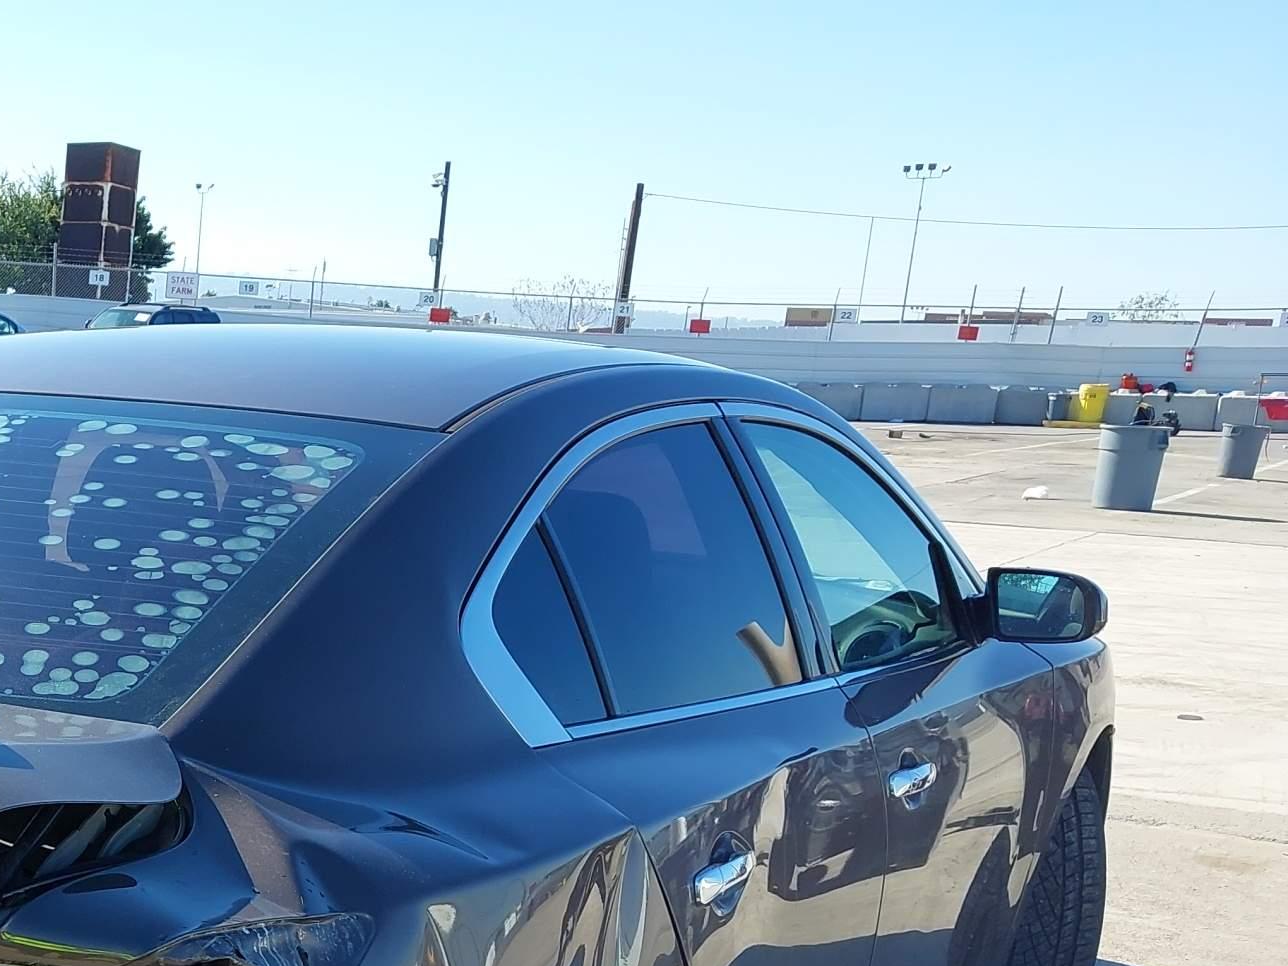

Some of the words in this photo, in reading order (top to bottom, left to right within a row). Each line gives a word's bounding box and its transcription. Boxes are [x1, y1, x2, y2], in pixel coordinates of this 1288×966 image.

[95, 274, 105, 282] 18
[171, 276, 195, 285] STATE
[171, 287, 193, 295] FARM
[243, 283, 254, 292] 19
[423, 295, 435, 304] 20
[619, 305, 630, 314] 21
[840, 311, 852, 319] 22
[1091, 314, 1104, 323] 23
